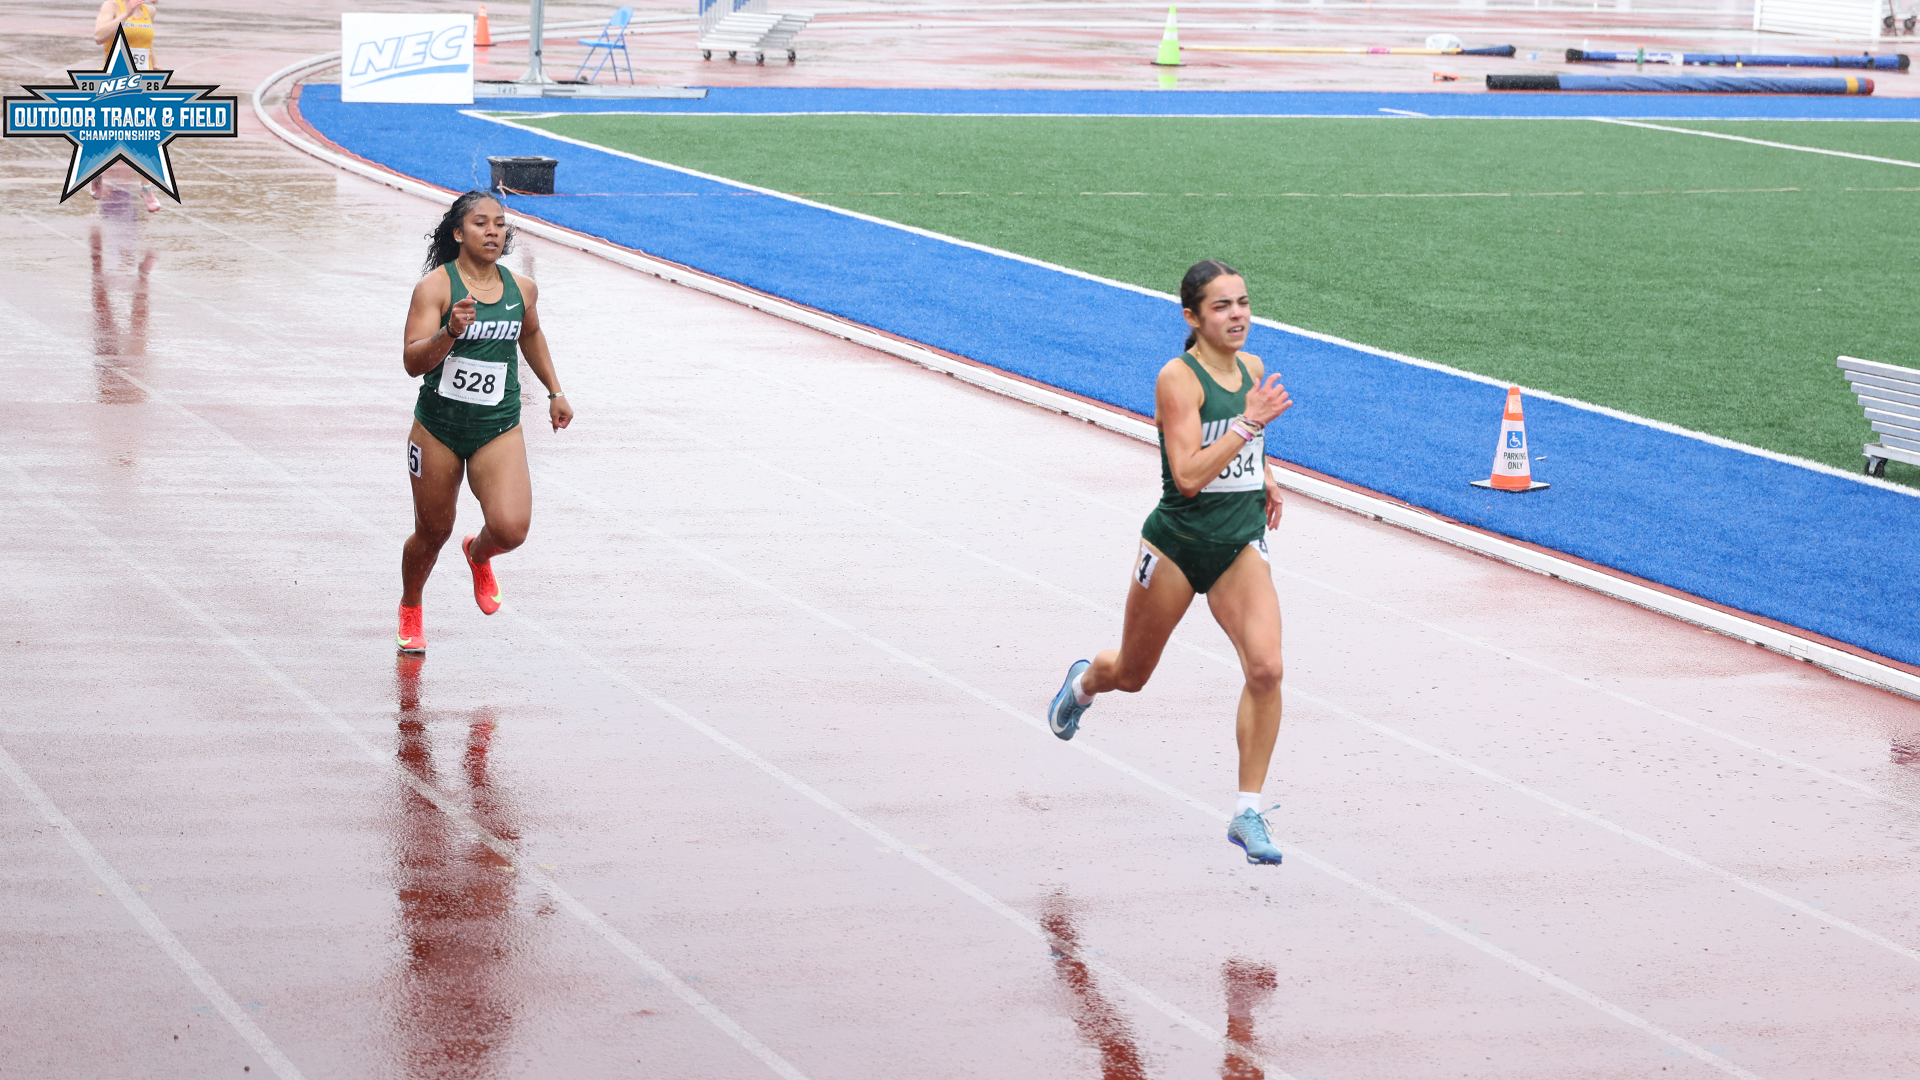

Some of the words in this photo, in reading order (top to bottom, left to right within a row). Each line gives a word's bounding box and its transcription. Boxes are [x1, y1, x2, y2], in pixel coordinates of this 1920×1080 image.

[350, 25, 468, 77] NEC
[452, 368, 496, 395] 528
[409, 445, 420, 474] 5
[1503, 452, 1526, 460] PARKING
[1507, 461, 1523, 470] ONLY
[1138, 552, 1153, 584] 4
